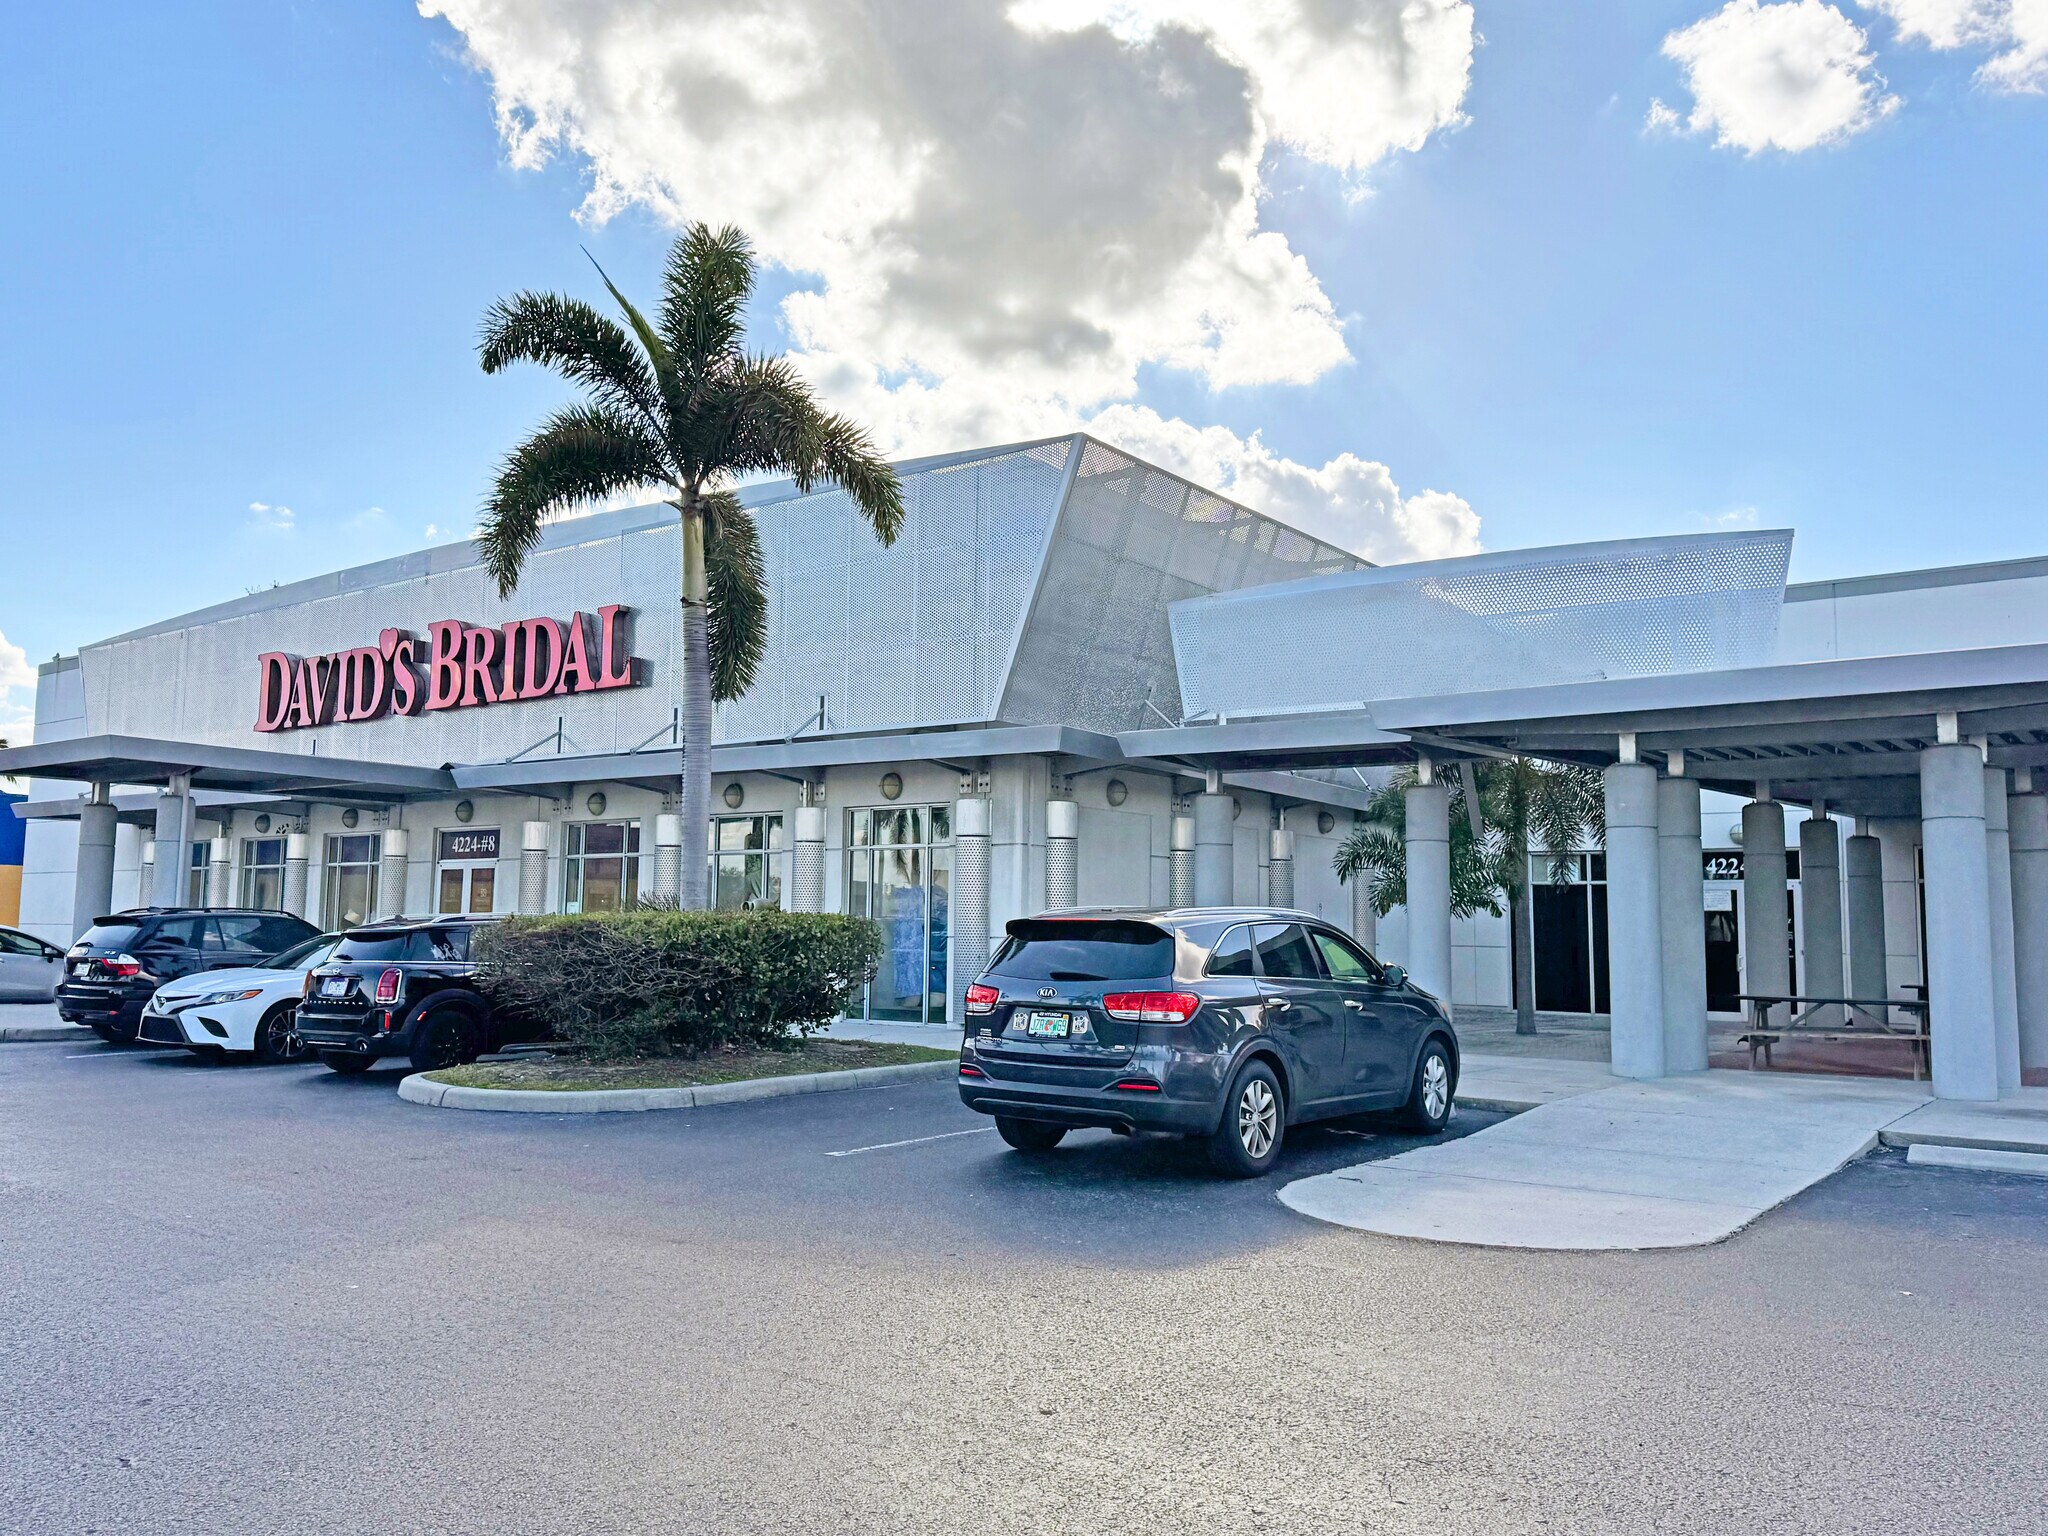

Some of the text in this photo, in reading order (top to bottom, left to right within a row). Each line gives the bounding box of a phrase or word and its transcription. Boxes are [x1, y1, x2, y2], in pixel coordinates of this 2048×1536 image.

[253, 603, 640, 733] DAVID'S BRIDAL
[451, 835, 496, 853] 4224-#8
[1040, 988, 1053, 997] KIA
